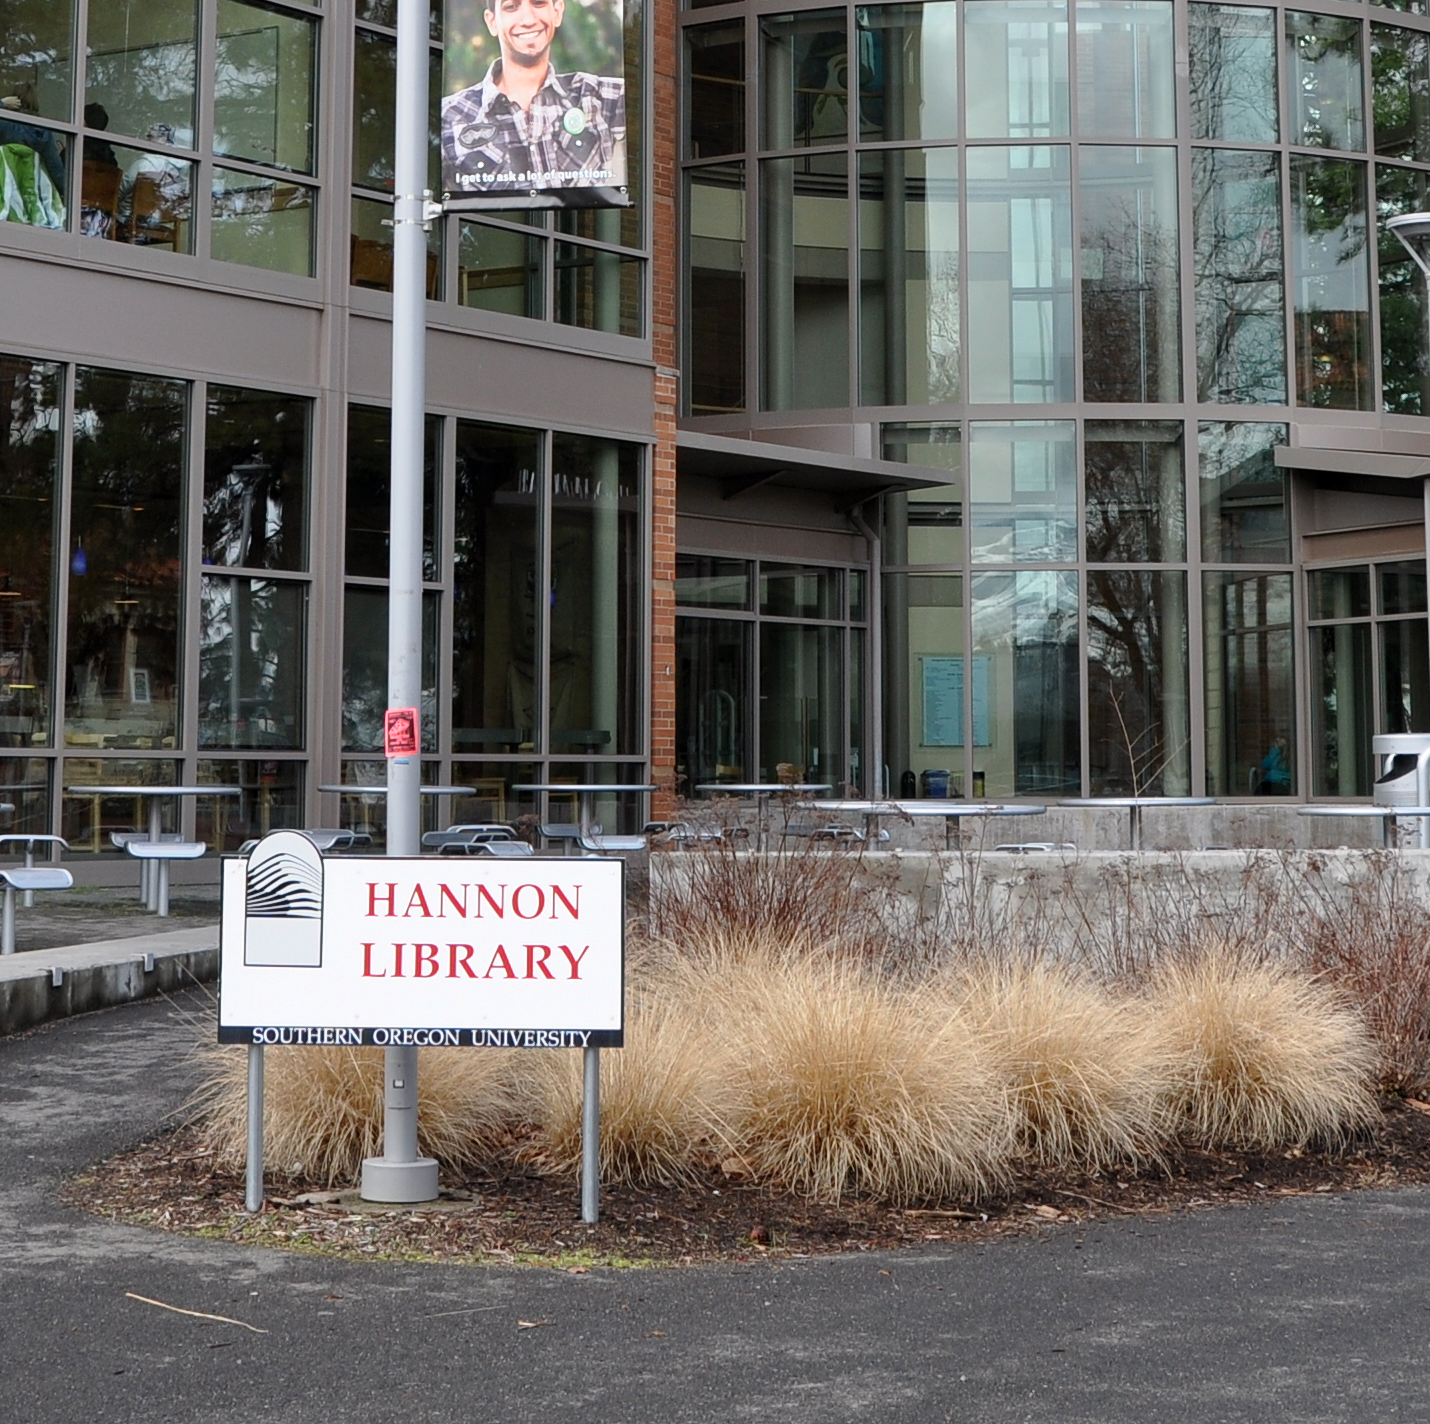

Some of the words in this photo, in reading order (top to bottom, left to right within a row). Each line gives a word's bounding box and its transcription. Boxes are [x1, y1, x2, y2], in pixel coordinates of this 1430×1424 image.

[455, 173, 460, 183] I
[482, 172, 495, 183] to
[496, 170, 516, 182] ask
[518, 172, 525, 182] a
[527, 169, 542, 181] lot
[544, 169, 556, 180] of
[558, 167, 616, 182] questions.
[364, 882, 583, 920] HANNON
[359, 942, 590, 980] LIBRARY
[252, 1027, 363, 1046] SOUTHERN
[372, 1028, 461, 1047] OREGON
[471, 1029, 592, 1048] UNIVERSITY
